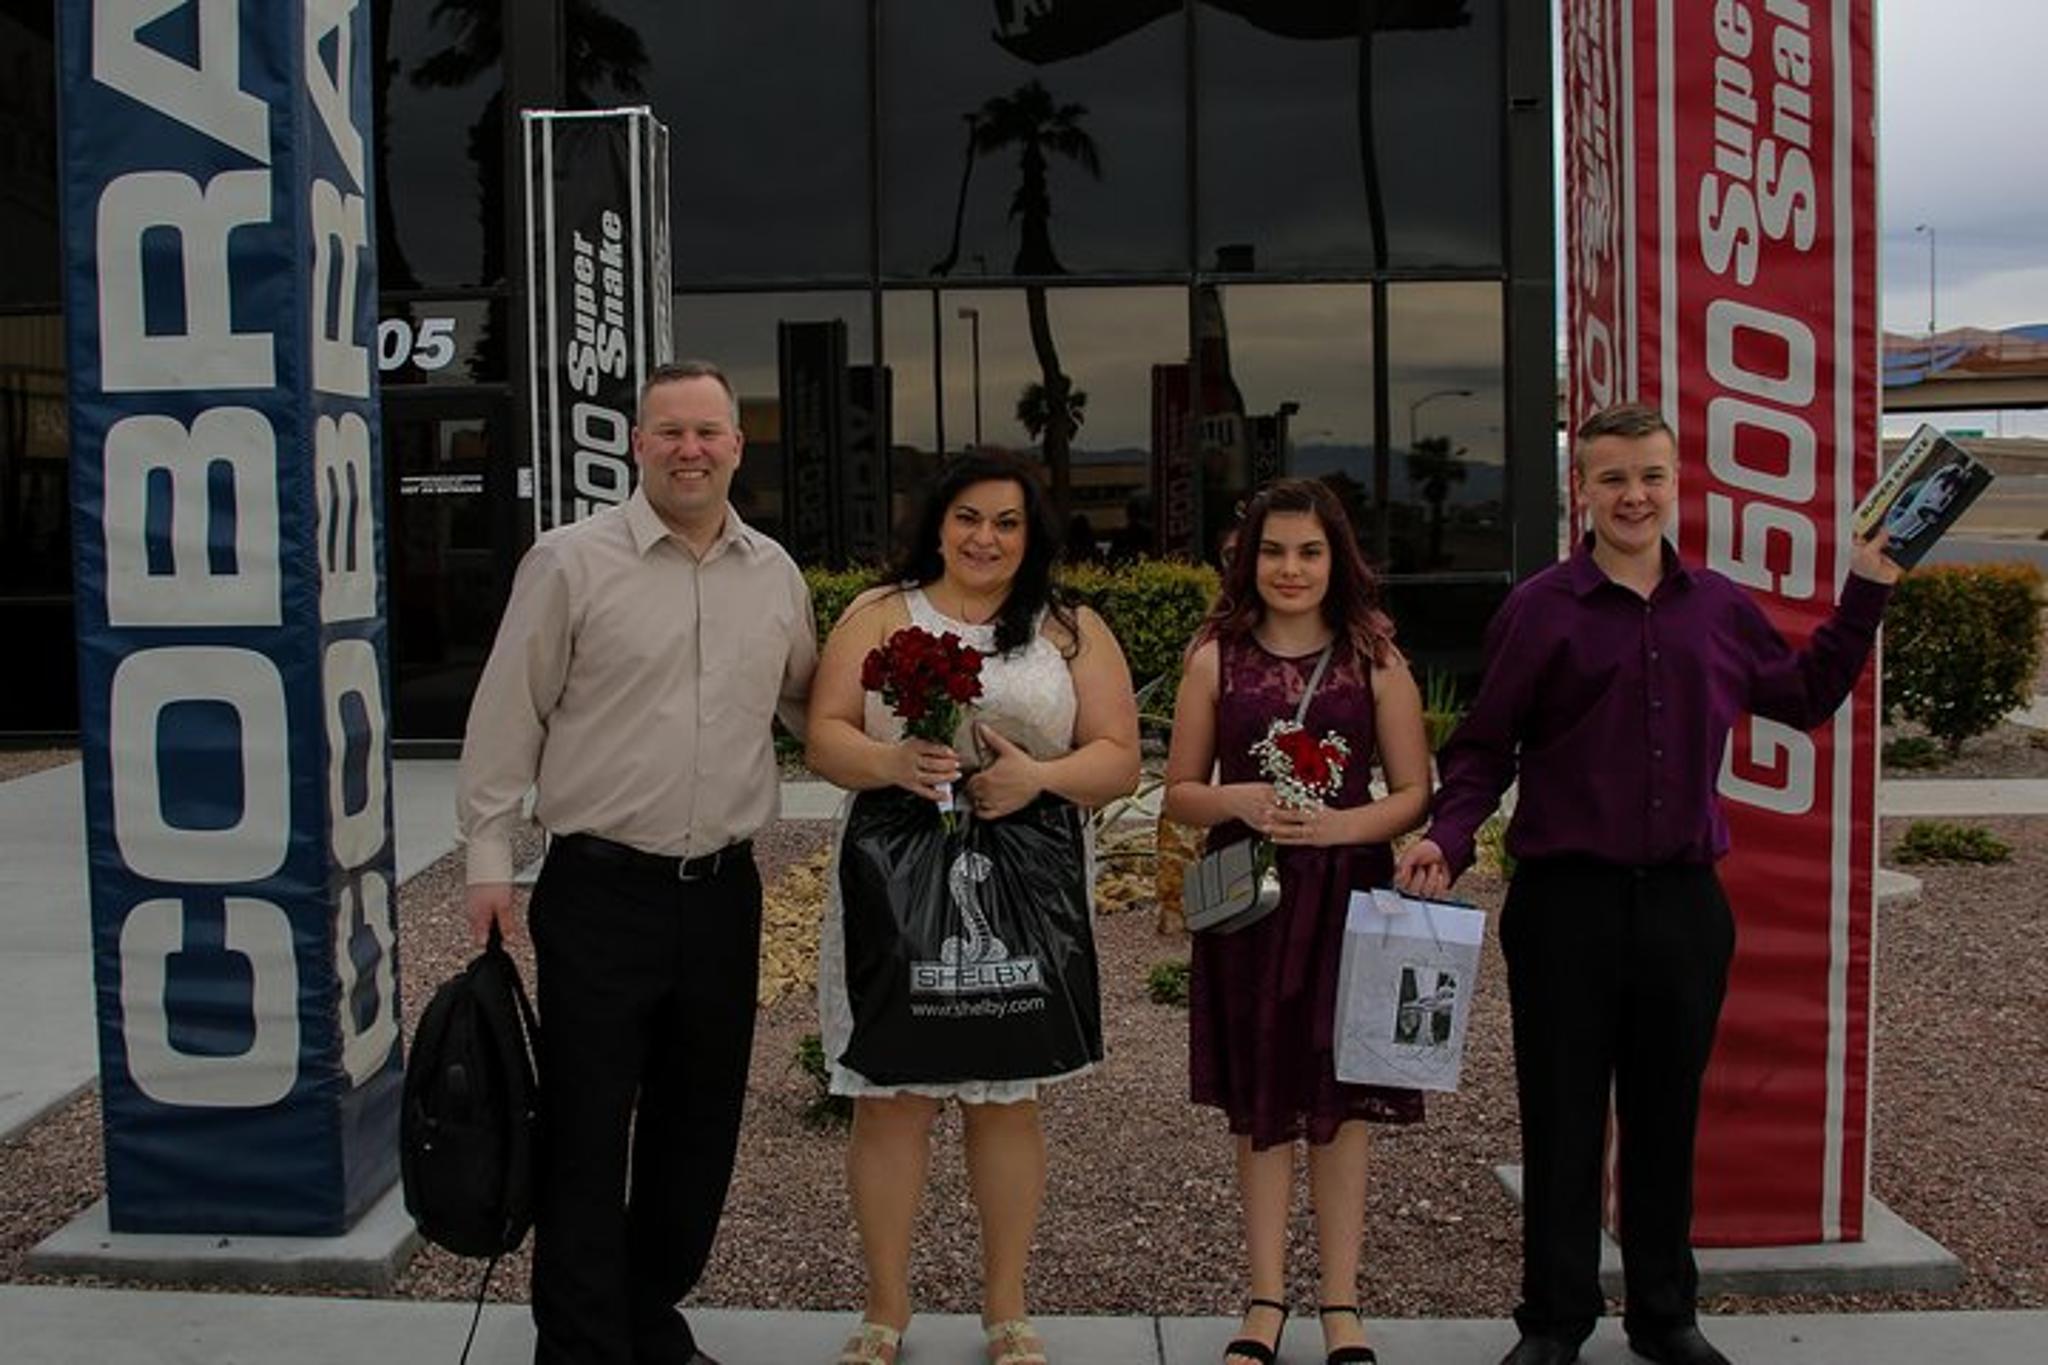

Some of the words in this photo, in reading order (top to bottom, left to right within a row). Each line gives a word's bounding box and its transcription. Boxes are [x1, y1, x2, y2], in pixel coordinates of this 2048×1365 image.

[378, 317, 456, 372] 05
[568, 230, 599, 396] Super
[597, 209, 628, 380] Snake
[93, 0, 300, 1108] COBRA
[910, 997, 1046, 1019] www.shelby.com
[917, 963, 1034, 988] SHELBY
